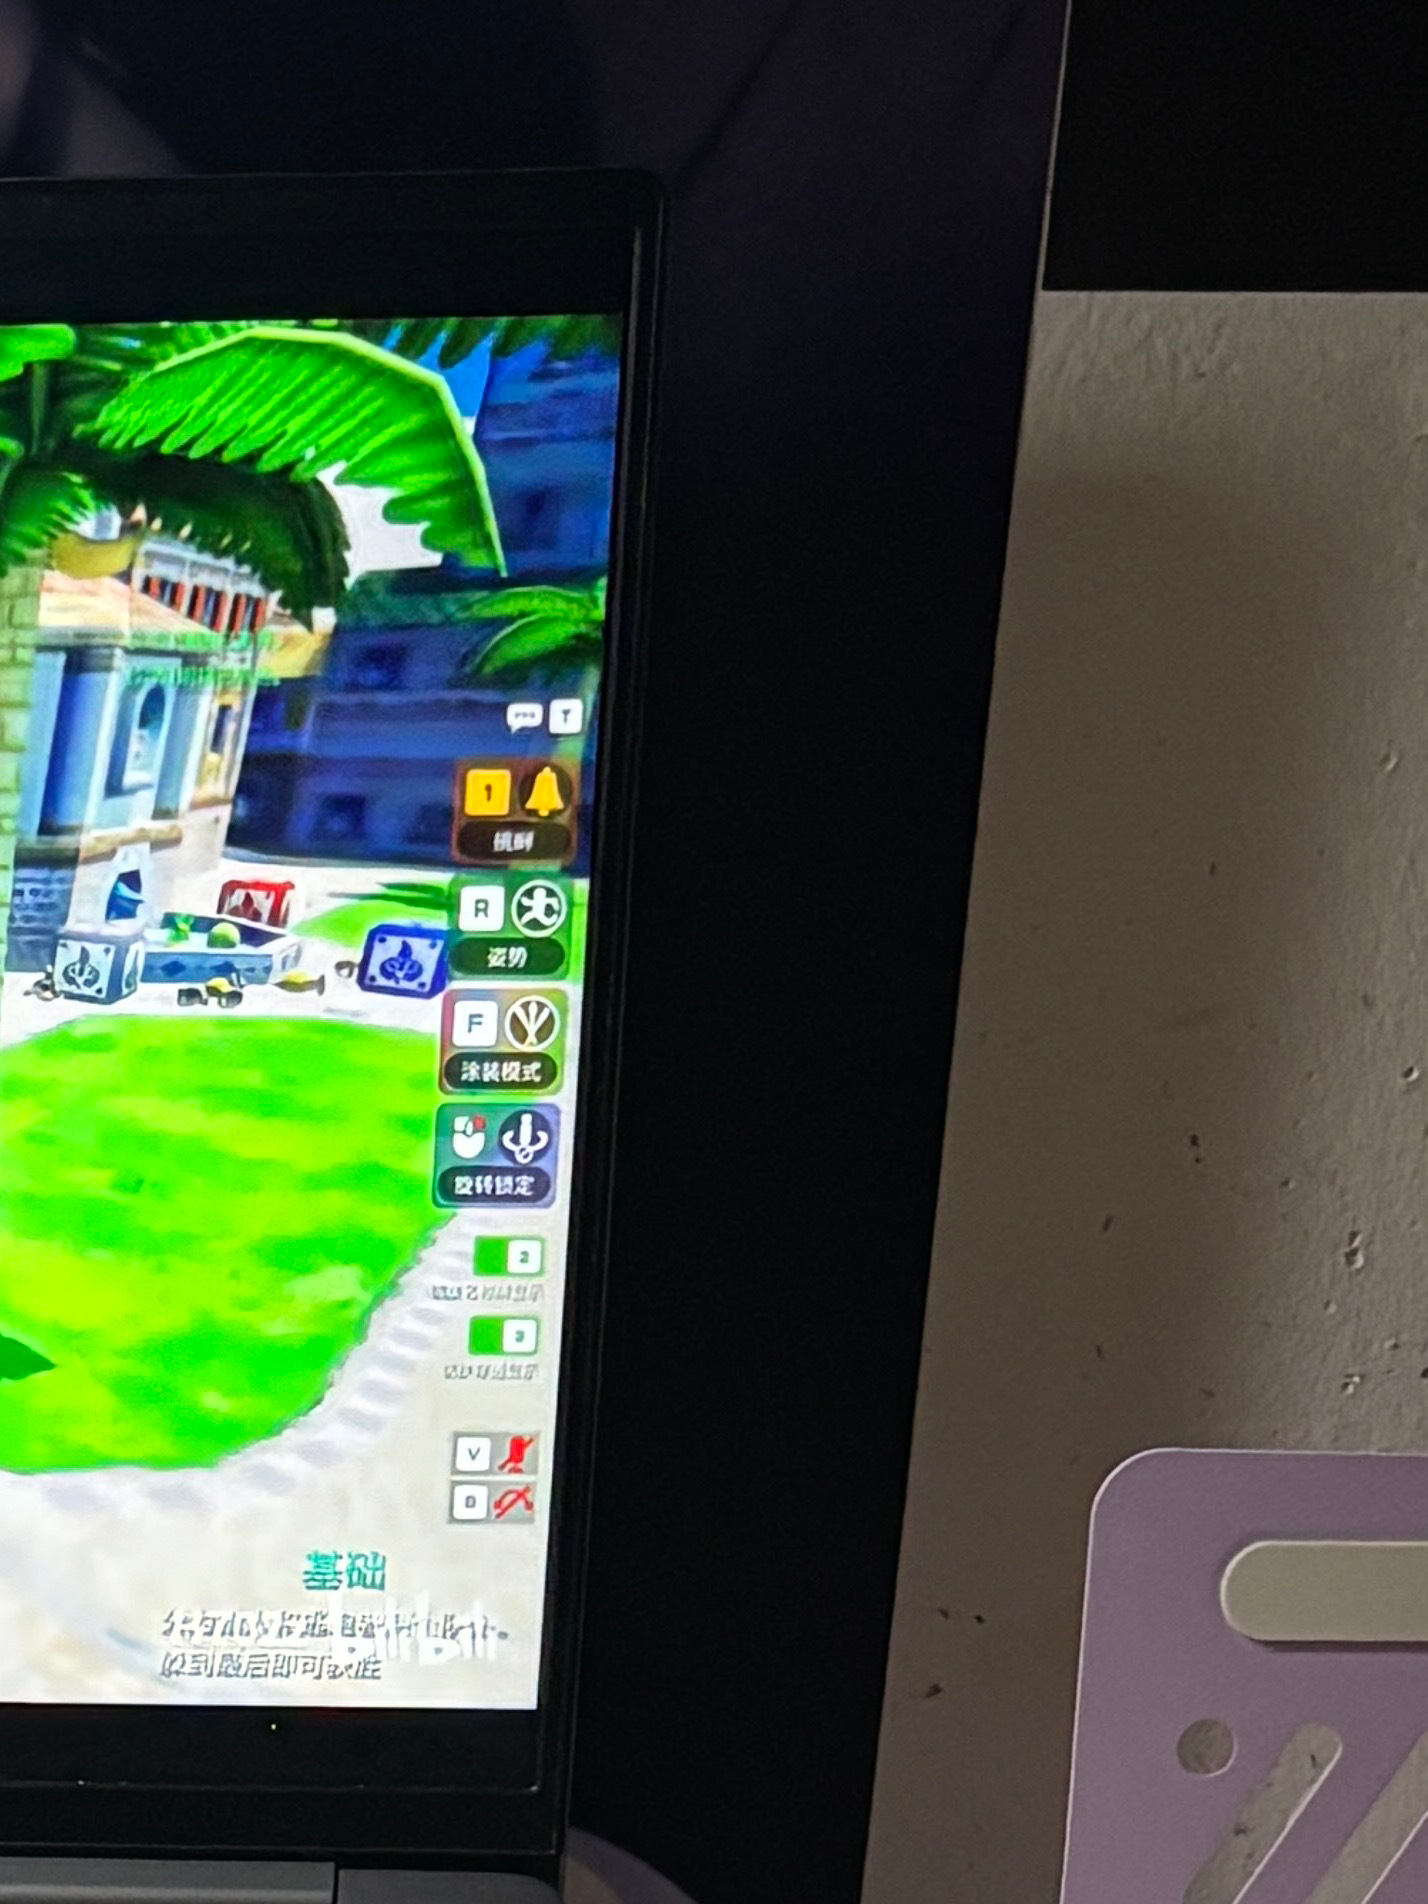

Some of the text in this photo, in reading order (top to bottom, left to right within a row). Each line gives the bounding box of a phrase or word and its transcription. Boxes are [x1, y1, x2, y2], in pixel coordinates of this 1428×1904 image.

[474, 900, 490, 919] R
[467, 1013, 484, 1033] F
[302, 1550, 388, 1592] 基础
